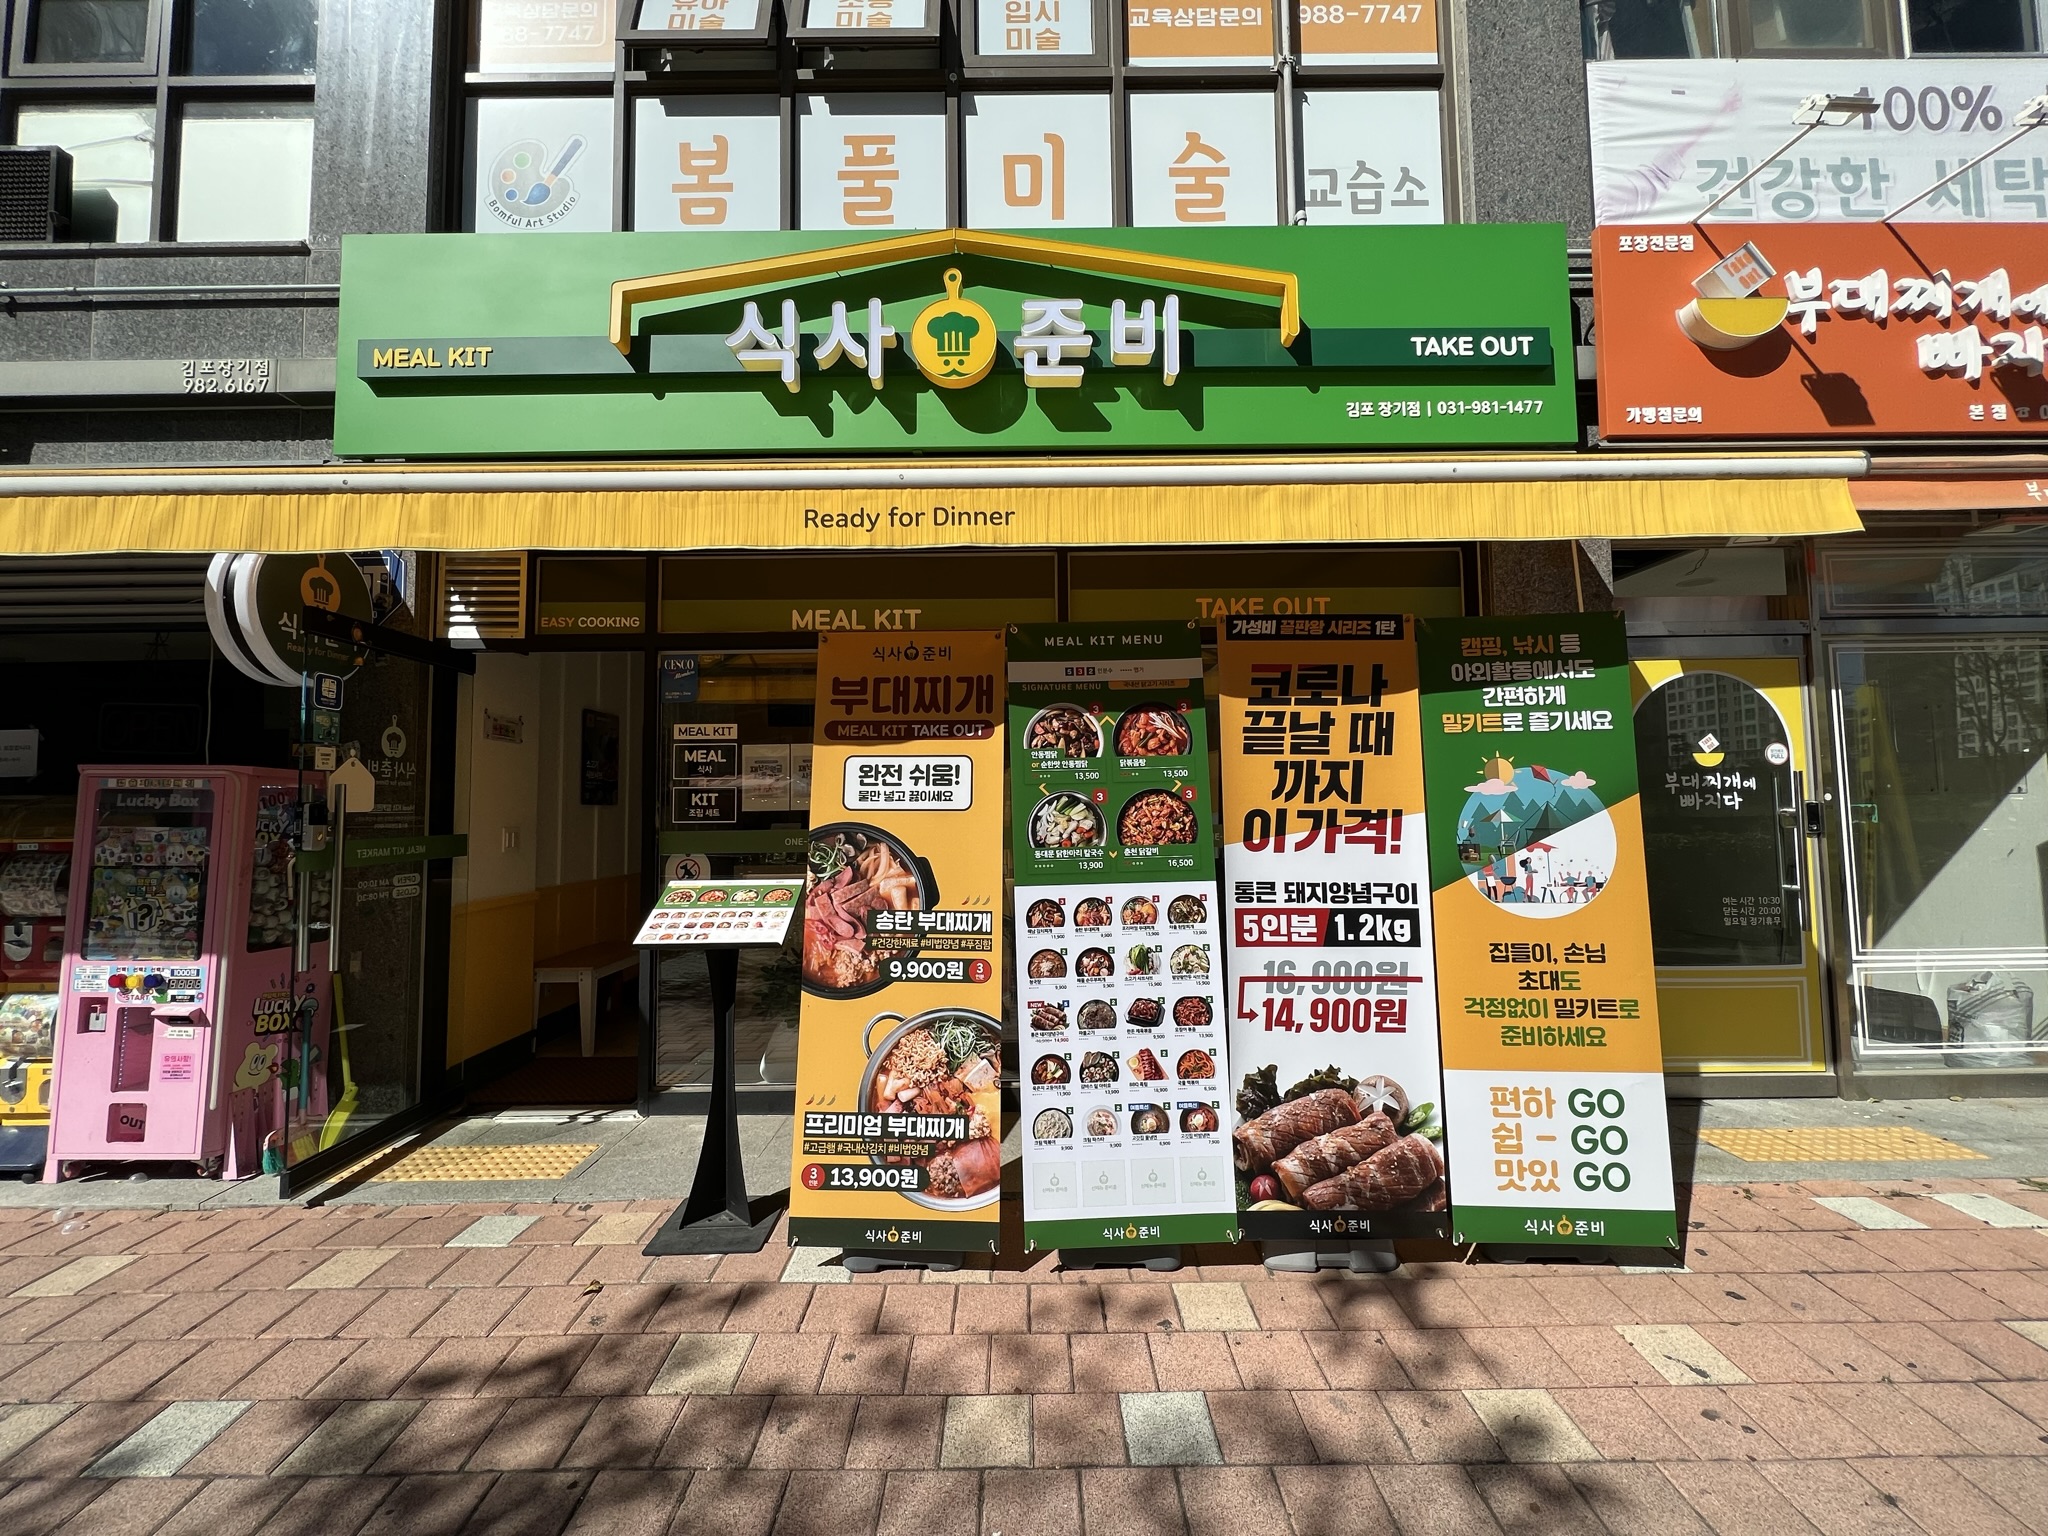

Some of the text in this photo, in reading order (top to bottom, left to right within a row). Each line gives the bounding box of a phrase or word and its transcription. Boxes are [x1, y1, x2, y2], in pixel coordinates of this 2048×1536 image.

[667, 13, 725, 30] 미술
[835, 11, 893, 29] 미술
[1006, 0, 1060, 23] 입시
[1129, 4, 1264, 28] 교육상담문의
[1299, 2, 1423, 25] 988-7747
[1006, 27, 1061, 50] 미술
[1305, 159, 1430, 215] 교습소
[1695, 156, 2048, 221] 건강한 세탁
[488, 196, 576, 228] Bomful Art Studio
[1618, 235, 1694, 252] 포장전문점
[724, 294, 1180, 393] 식사 준비
[1410, 335, 1534, 358] TAKE OUT
[373, 346, 493, 370] MEAL KIT
[181, 360, 270, 378] 김포장기점
[183, 378, 269, 393] 982.6167
[1346, 400, 1544, 419] 김포 장기점 031-981-1477
[1626, 406, 1702, 423] 가맹점문의
[804, 505, 1016, 533] Ready for Dinner
[1196, 597, 1331, 618] TAKE OUT
[541, 616, 641, 628] EASY COOKING
[791, 609, 922, 631] MEAL KIT
[1232, 620, 1396, 635] 가성비 끝판왕 시리즈 1탄
[1044, 634, 1163, 647] MEAL KIT MENU
[1461, 634, 1581, 657] 캠핑, 낚시 등
[872, 646, 952, 662] 식사 준비
[664, 659, 694, 671] CESCO
[1451, 659, 1596, 682] 야외활동에서도
[830, 674, 995, 716] 부대찌개
[1022, 682, 1101, 692] SIGNATURE MENU
[1247, 663, 1389, 708] 코로나
[1482, 685, 1567, 708] 간편하게
[678, 727, 734, 737] MEAL KIT
[837, 724, 985, 737] MEAL KIT TAKE OUT
[1442, 710, 1614, 733] 밀키트로 즐기세요
[1242, 710, 1395, 756] 끝날 때
[684, 750, 726, 763] MEAL
[697, 765, 712, 775] 식사
[858, 764, 960, 787] 완전 쉬움!
[1075, 772, 1100, 780] 13,500
[1163, 769, 1188, 778] 13,500
[1271, 760, 1364, 804] 까지
[1665, 772, 1757, 794] 부대찌개에
[116, 793, 199, 809] Lucky Box
[691, 793, 719, 806] KIT
[858, 790, 954, 803] 물만 넣고 끓이세요
[1680, 792, 1743, 810] 빠지다
[705, 808, 720, 817] 세트
[1294, 808, 1403, 854] 가격!
[1078, 861, 1103, 870] 13,900
[1168, 859, 1194, 868] 16,500
[1235, 881, 1418, 905] 통큰 돼지양념구이
[1722, 896, 1781, 906] 여는 시간 10:30
[876, 910, 991, 933] 송탄 부대찌개
[1722, 906, 1781, 916] 닫는 시간 20:00
[1723, 916, 1781, 926] 일요일 정기휴무
[1243, 913, 1412, 943] 5인분 1.2kg
[871, 938, 991, 950] #건강한재료 #비법양념 #푸짐함
[1489, 942, 1607, 965] 집들이, 손님
[889, 960, 964, 980] 9,900원
[1263, 960, 1409, 996] 16,900원
[1518, 970, 1582, 991] 초대도
[1262, 998, 1408, 1033] 14,900원
[1464, 997, 1640, 1020] 걱정없이 밀키트로
[256, 1012, 296, 1033] BOX
[1501, 1026, 1607, 1047] 준비하세요
[1489, 1085, 1626, 1119] 편하 GO
[120, 1115, 146, 1130] OUT
[805, 1115, 965, 1139] 프리미엄 부대찌개
[837, 1143, 886, 1154] #국내산김치
[888, 1144, 929, 1156] #비법양념
[1491, 1122, 1629, 1156] 쉽 GO
[830, 1168, 918, 1189] 13,900원
[1494, 1159, 1631, 1193] 맛있 GO
[865, 1229, 922, 1244] 식사 준비
[1103, 1226, 1160, 1240] 식사 준비
[1309, 1218, 1371, 1234] 식사 준비
[1524, 1219, 1605, 1237] 식사 준비
